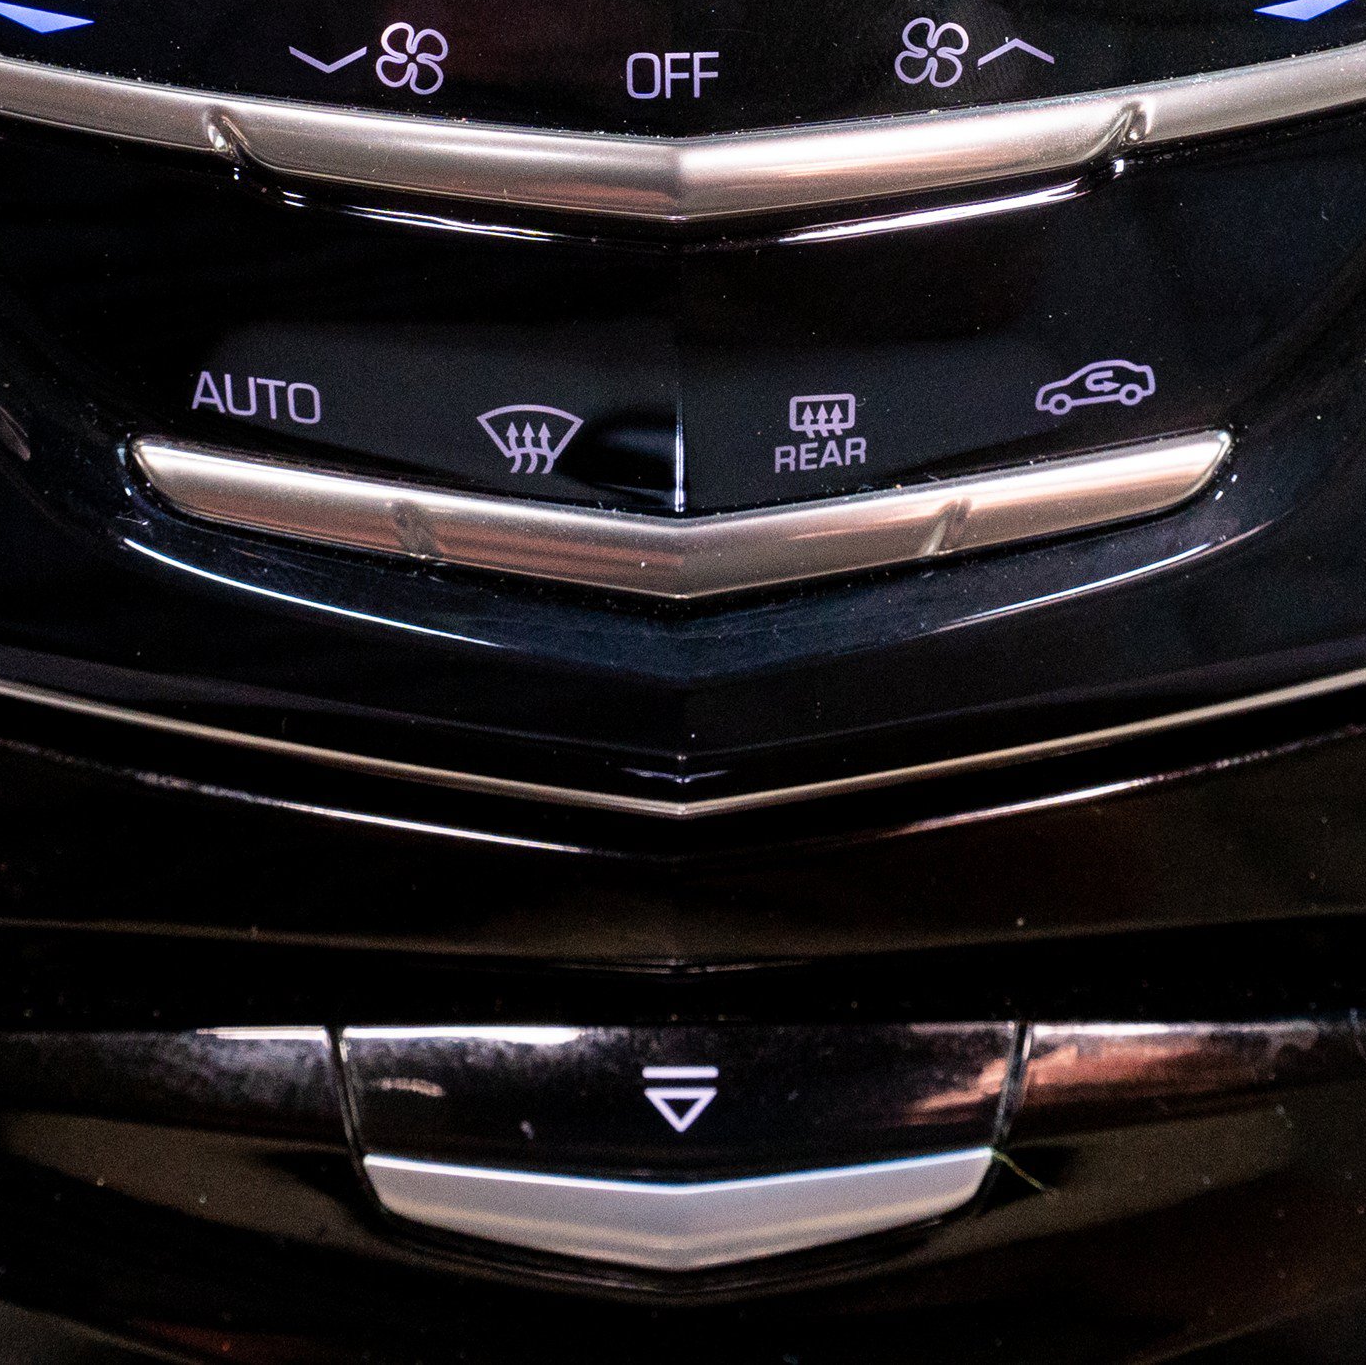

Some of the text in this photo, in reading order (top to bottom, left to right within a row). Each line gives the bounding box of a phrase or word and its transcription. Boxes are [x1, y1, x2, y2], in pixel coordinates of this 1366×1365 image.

[626, 51, 720, 100] OFF
[191, 370, 322, 425] AUTO
[773, 436, 868, 473] REAR
